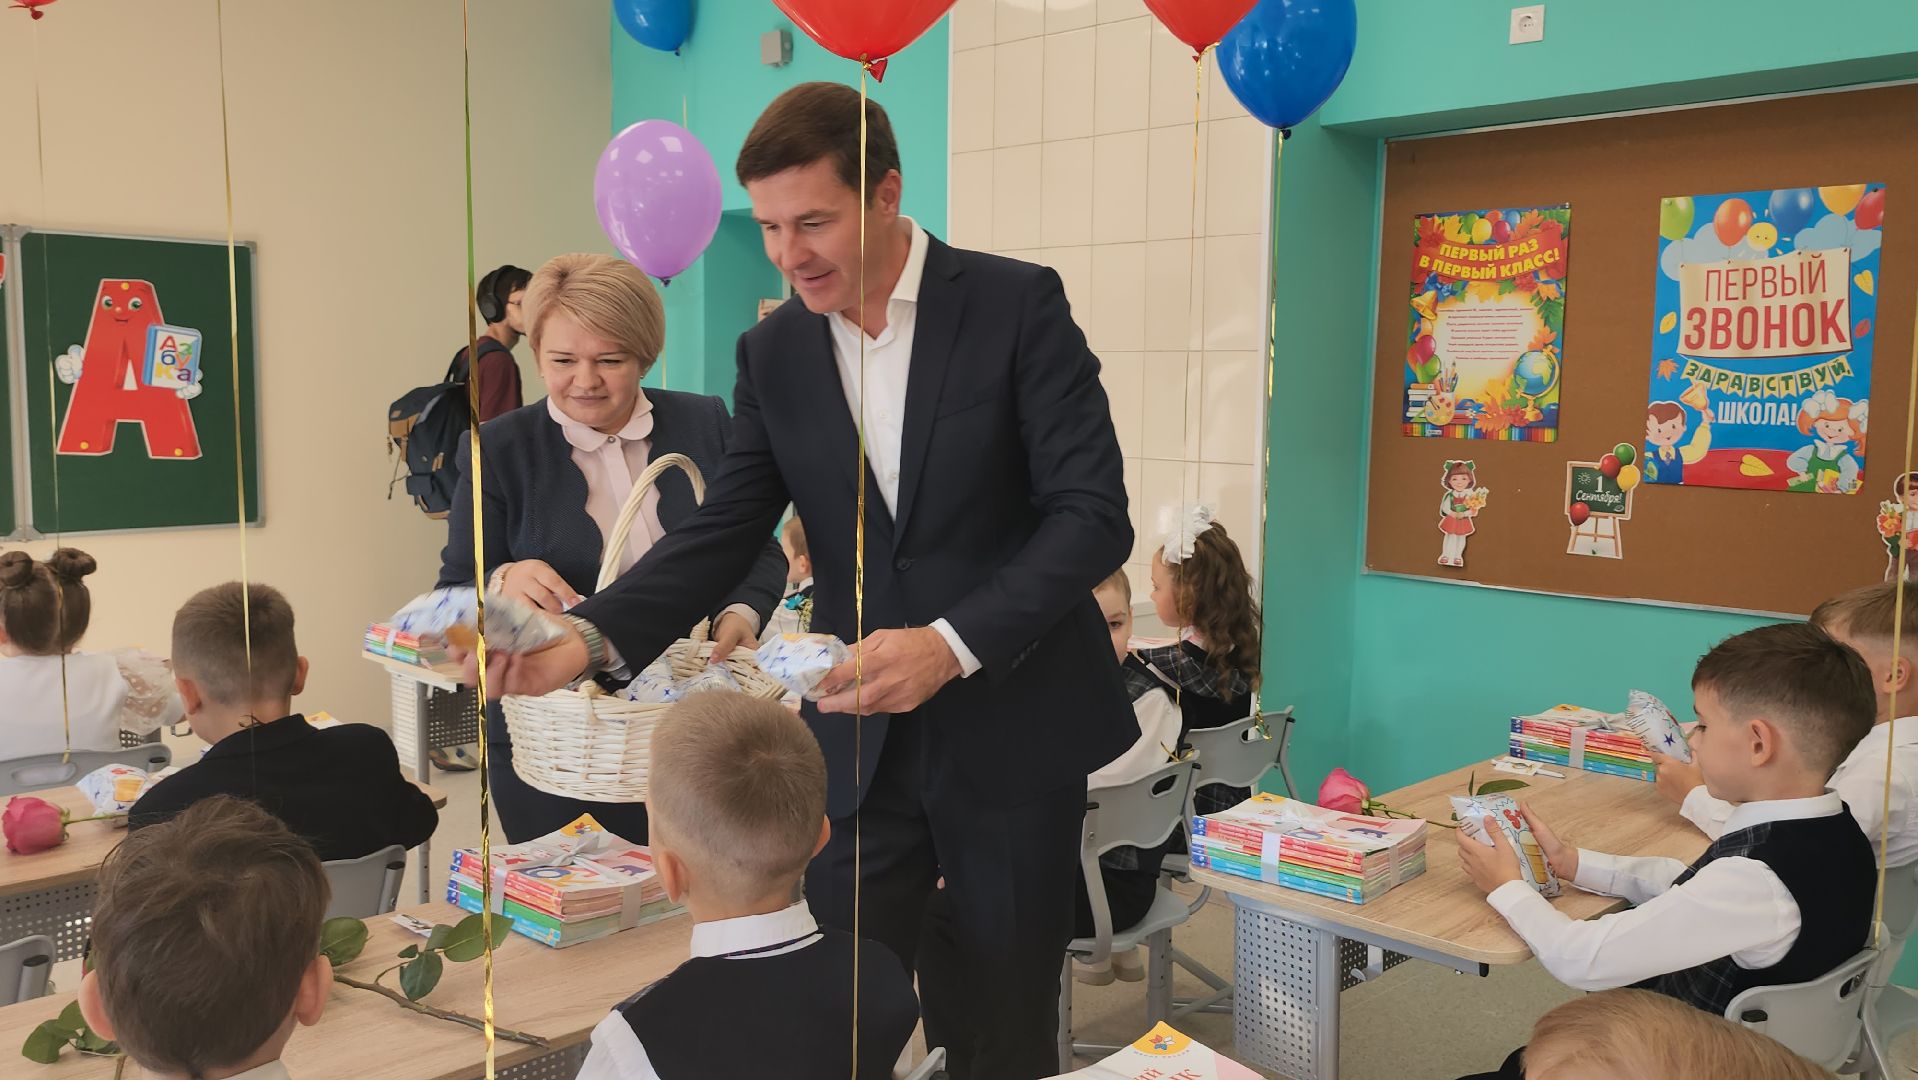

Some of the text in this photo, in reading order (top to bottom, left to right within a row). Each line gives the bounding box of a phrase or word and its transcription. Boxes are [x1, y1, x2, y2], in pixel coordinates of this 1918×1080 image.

[1418, 247, 1560, 280] В ПЕРВЫЙ КЛАСС!
[1439, 238, 1539, 262] ПЕРВЫЙ РАЗ
[1704, 252, 1827, 302] ПЕРВЫЙ
[1683, 298, 1848, 351] ЗВОНОК
[1717, 401, 1798, 426] ШКОЛА!
[1595, 475, 1604, 493] 1
